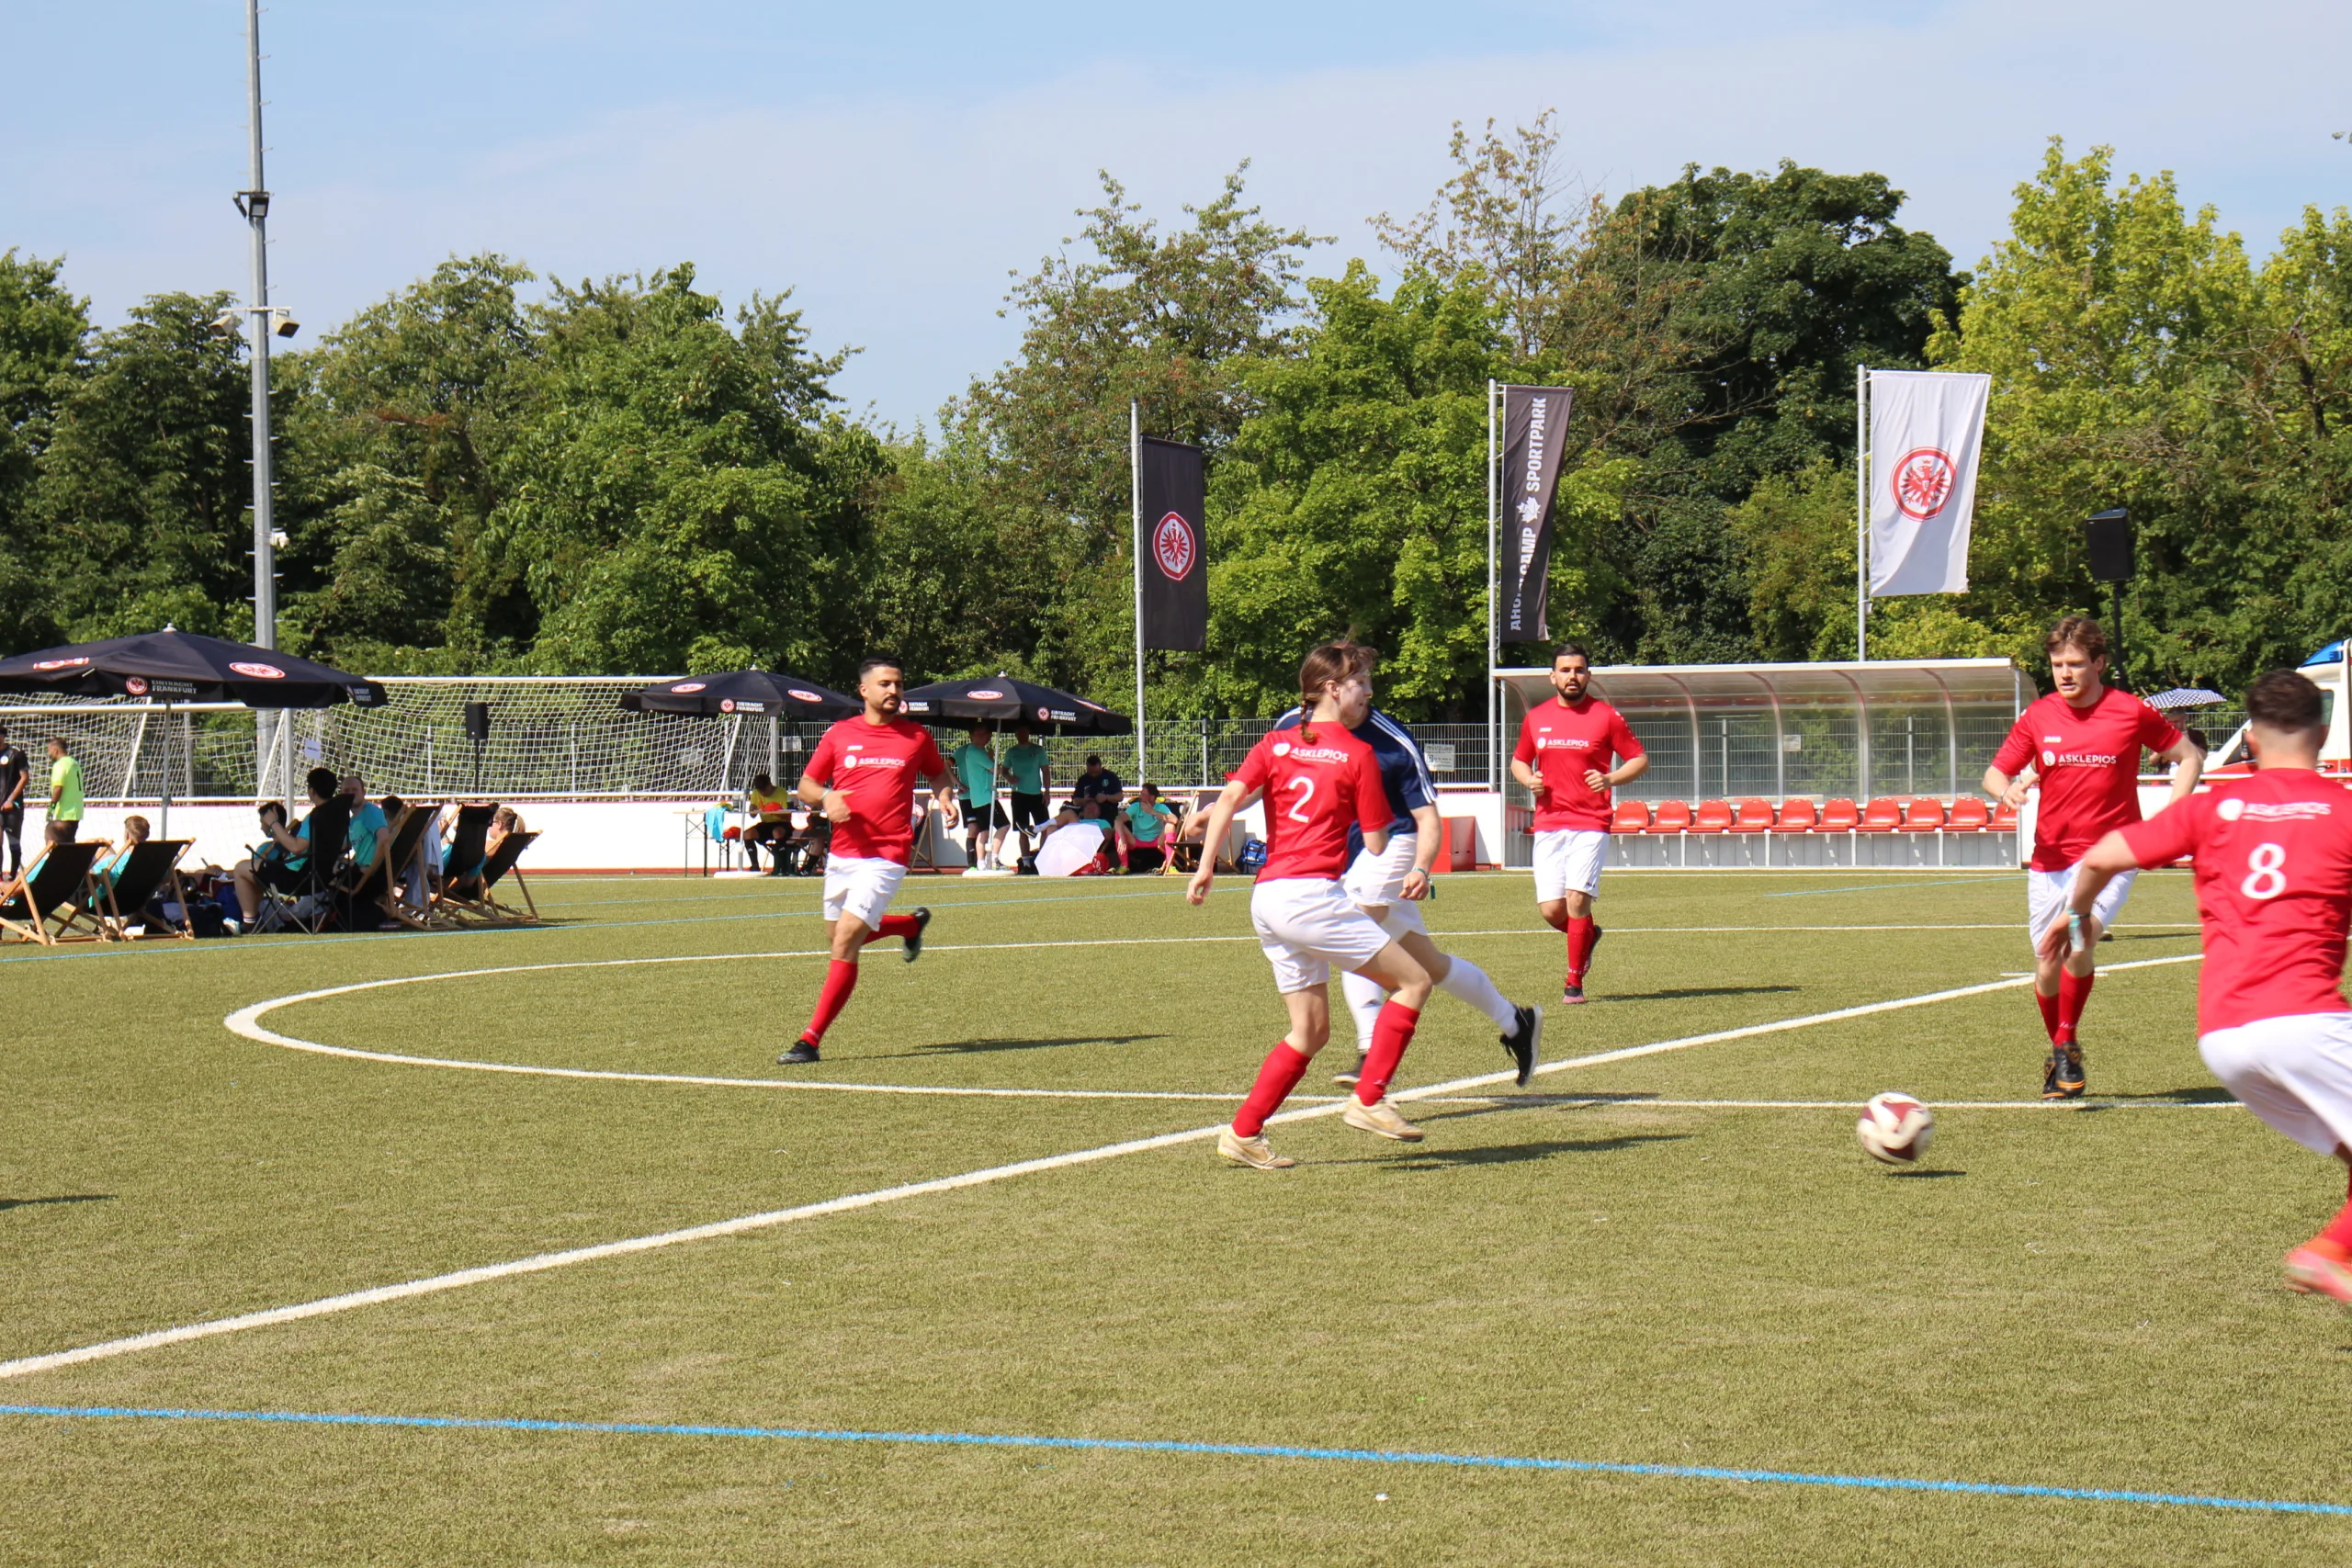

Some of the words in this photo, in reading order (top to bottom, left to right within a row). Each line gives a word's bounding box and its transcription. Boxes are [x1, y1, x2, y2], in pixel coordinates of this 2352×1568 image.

[1510, 527, 1536, 631] AHOCAMP
[1526, 397, 1547, 492] SPORTPARK
[152, 685, 197, 694] FRANKFURT
[1547, 739, 1589, 748] ASKLEPIOS
[1291, 747, 1349, 763] ASKLEPIOS
[2058, 754, 2117, 764] ASKLEPIOS
[858, 757, 906, 767] ASKLEPIOS
[1288, 775, 1315, 824] 2
[2240, 842, 2288, 900] 8
